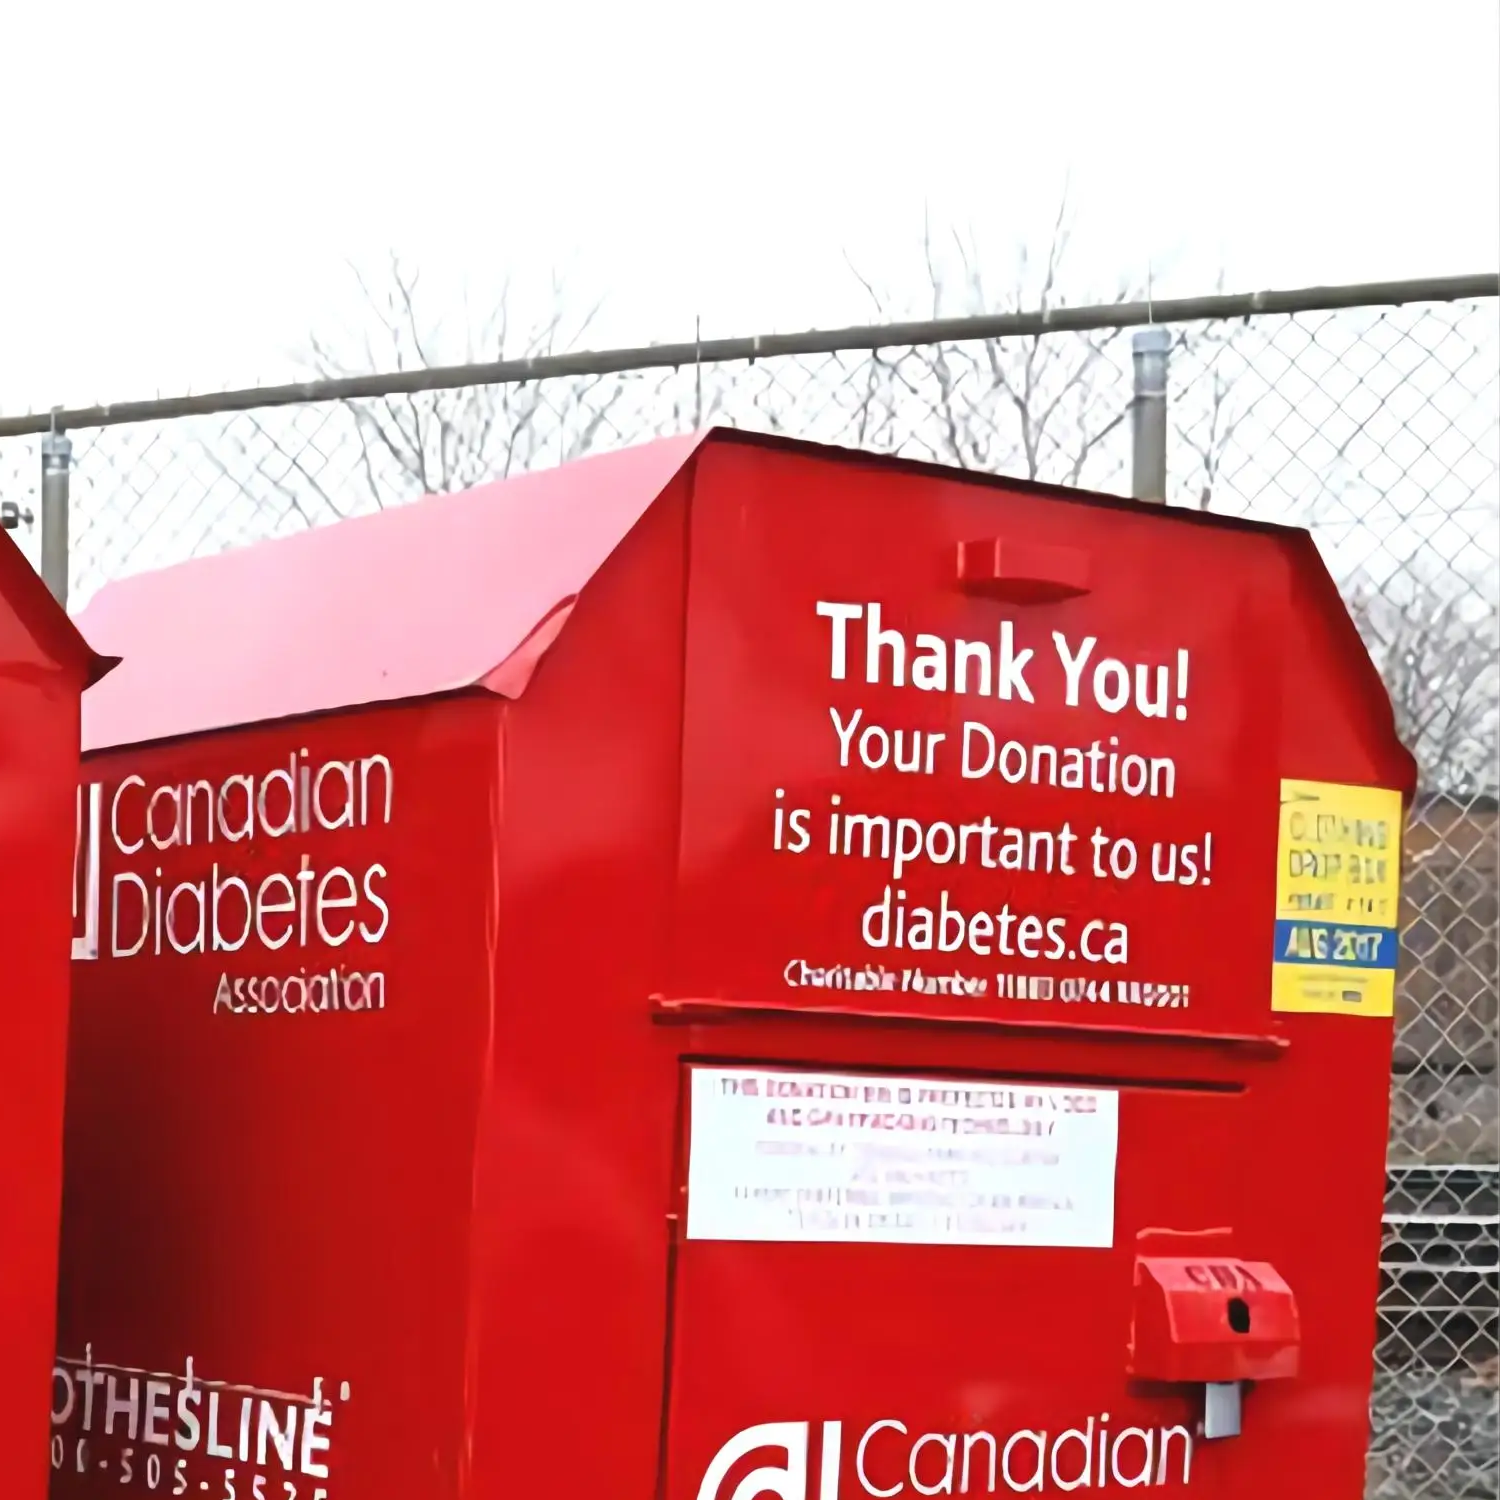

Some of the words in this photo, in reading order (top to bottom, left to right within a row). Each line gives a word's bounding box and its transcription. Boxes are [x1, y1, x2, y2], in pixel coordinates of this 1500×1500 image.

[817, 601, 1034, 703] Thank
[1052, 630, 1188, 721] You!
[830, 707, 945, 774] Your
[962, 721, 1175, 798] Donation
[111, 748, 393, 855] Canadian
[774, 788, 810, 852] is
[829, 795, 1076, 879] important
[1090, 826, 1137, 879] to
[1152, 832, 1212, 885] us!
[111, 854, 388, 957] Diabetes
[863, 885, 1128, 964] diabetes.ca
[213, 963, 385, 1014] Association
[856, 1412, 1191, 1498] Canadian
